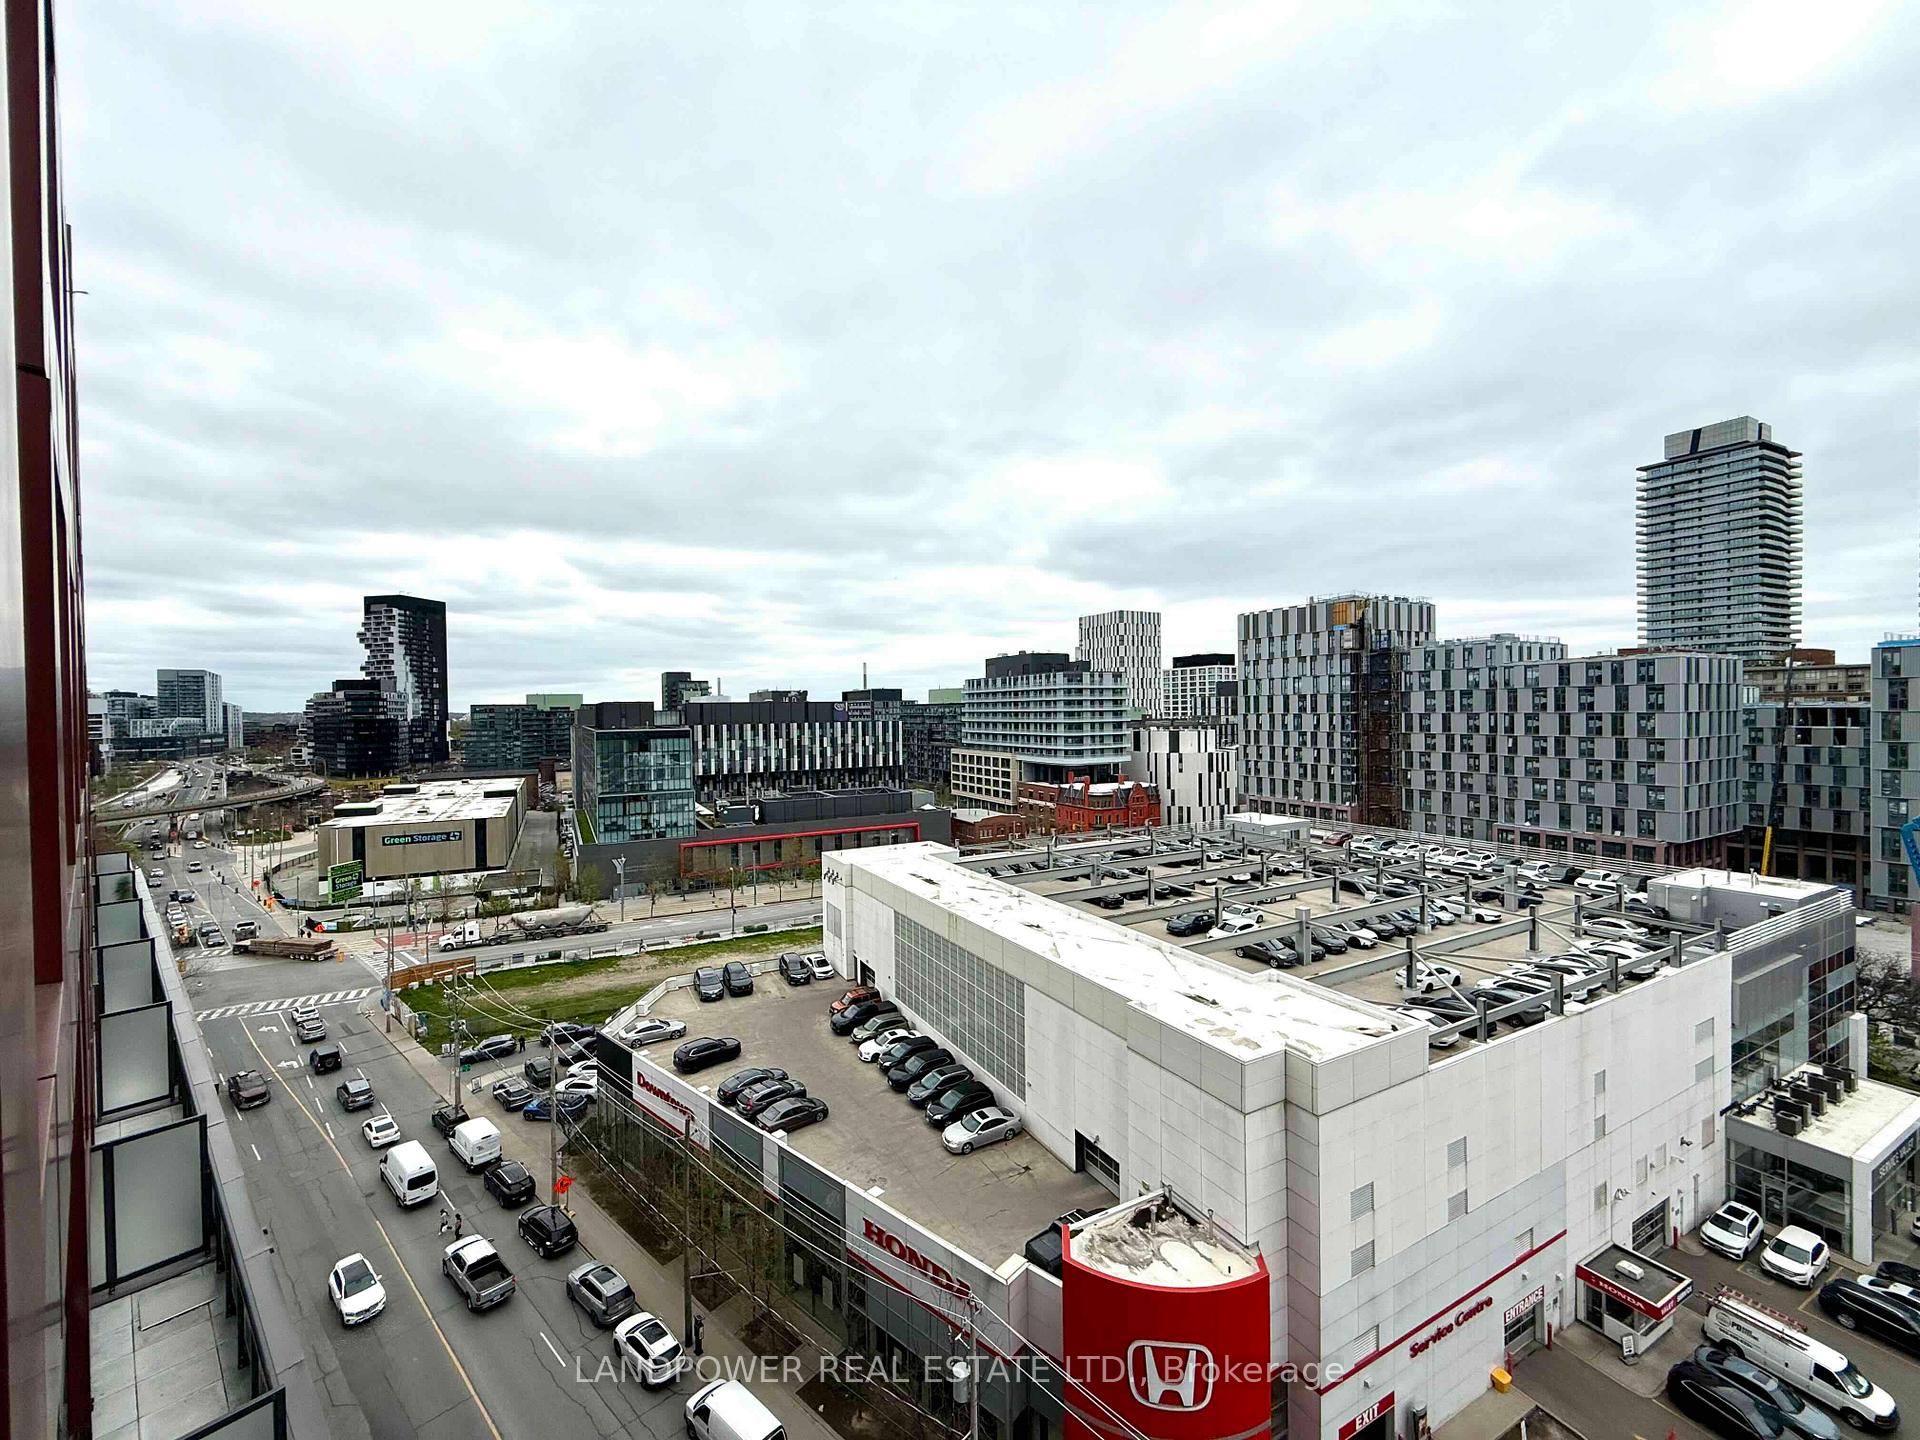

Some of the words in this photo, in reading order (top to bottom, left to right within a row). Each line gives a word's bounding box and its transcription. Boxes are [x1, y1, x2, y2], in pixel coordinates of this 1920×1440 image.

[384, 836, 411, 845] Green
[413, 834, 447, 842] Storage
[637, 1071, 695, 1122] Downtown
[1505, 1287, 1544, 1322] ENTRANCE
[1599, 1280, 1647, 1311] HONDA
[1409, 1322, 1454, 1358] Service
[1454, 1296, 1493, 1327] Centre
[1355, 1403, 1380, 1431] EXIT
